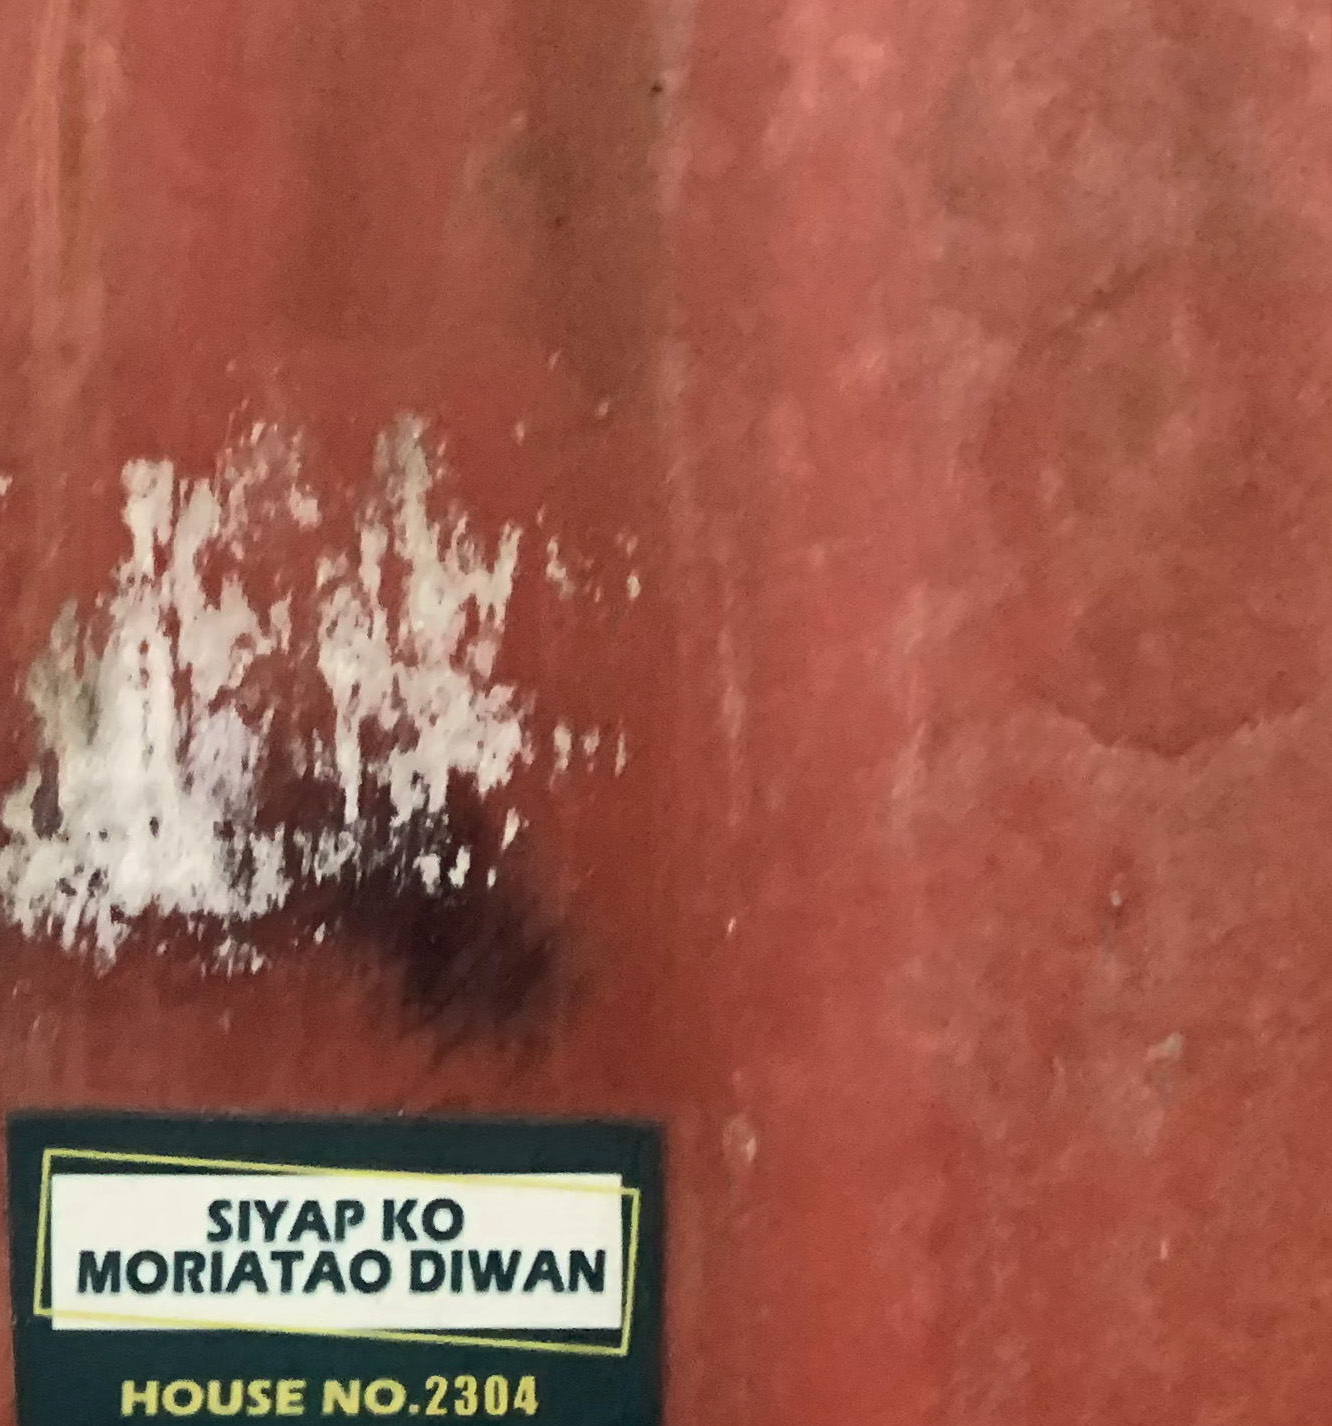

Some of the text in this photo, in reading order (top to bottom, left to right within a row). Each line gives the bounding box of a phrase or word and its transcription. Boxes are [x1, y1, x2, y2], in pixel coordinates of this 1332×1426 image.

[206, 1197, 464, 1244] SIYAP KO
[76, 1249, 606, 1295] MORIATAO DIWAN
[119, 1378, 307, 1417] HOUSE
